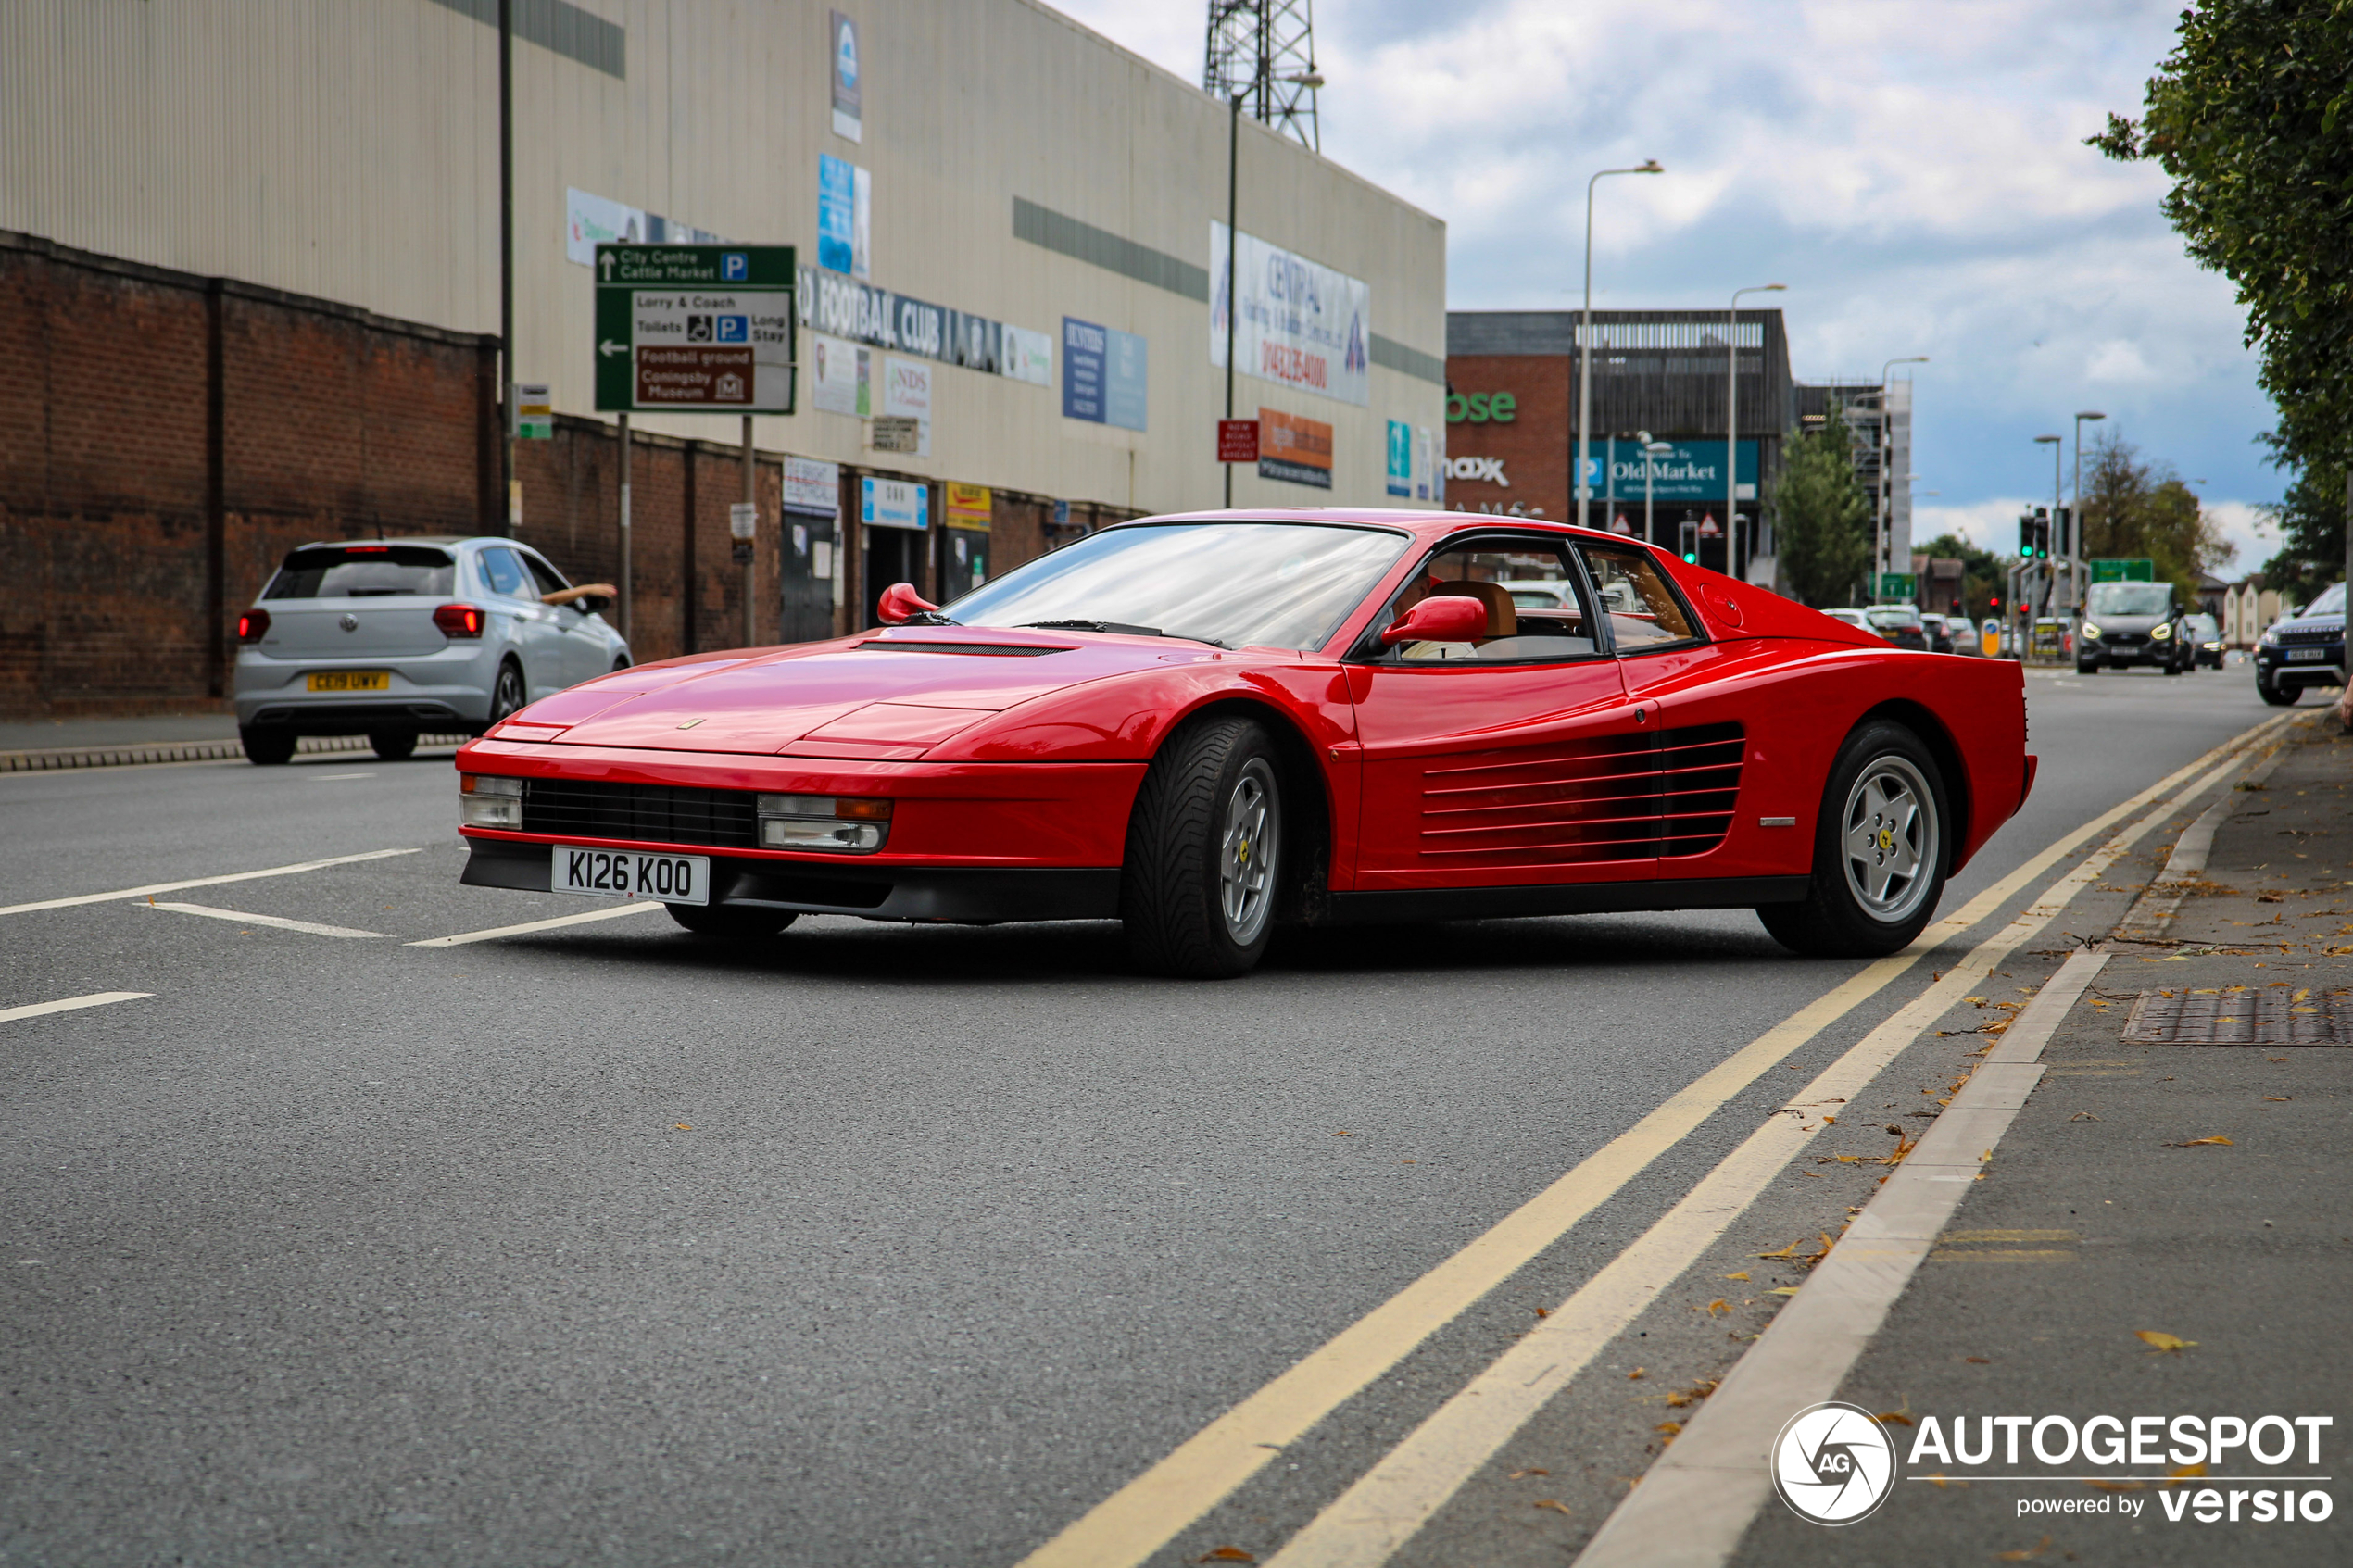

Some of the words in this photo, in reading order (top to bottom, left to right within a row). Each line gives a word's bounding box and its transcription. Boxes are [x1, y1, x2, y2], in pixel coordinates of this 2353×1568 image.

[620, 250, 648, 265] City
[651, 250, 698, 264] Centre
[620, 265, 663, 279] Cattle
[667, 266, 714, 279] Market
[727, 256, 743, 276] P
[637, 296, 673, 310] Lorry
[679, 296, 687, 308] &
[693, 296, 736, 309] Coach
[751, 314, 785, 328] Long
[819, 277, 897, 345] FOOTBALL
[901, 301, 940, 354] CLUB
[637, 320, 682, 333] Toilets
[752, 330, 785, 343] Stay
[641, 349, 698, 364] Football
[701, 351, 749, 367] ground
[641, 370, 711, 387] Coningsby
[649, 385, 705, 398] Museum
[1612, 461, 1646, 480] Old
[1651, 461, 1716, 480] Market
[569, 850, 629, 891] K126
[637, 856, 691, 896] KOO
